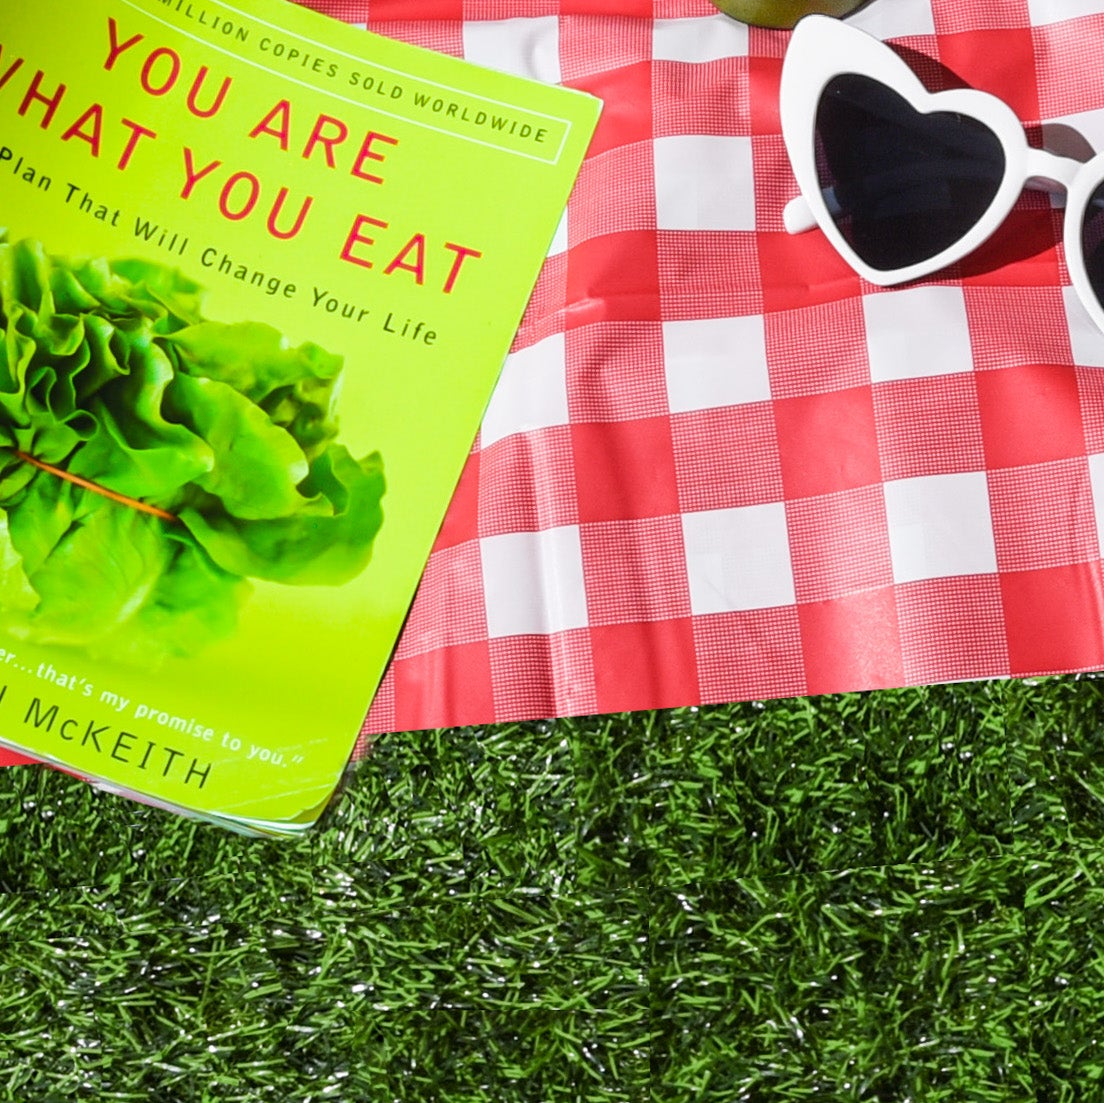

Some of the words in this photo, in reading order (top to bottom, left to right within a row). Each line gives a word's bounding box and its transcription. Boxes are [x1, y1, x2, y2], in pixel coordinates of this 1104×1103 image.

[103, 16, 233, 118] YOU
[248, 98, 399, 185] ARE
[259, 38, 339, 78] COPIES
[349, 71, 403, 100] SOLD
[413, 92, 548, 143] WORLDWIDE
[65, 182, 121, 227] That
[134, 217, 189, 256] Will
[201, 248, 297, 298] Change
[312, 287, 370, 322] Your
[383, 313, 437, 346] Life
[180, 146, 314, 240] YOU
[339, 213, 482, 294] EAT
[23, 697, 212, 789] McKEITH
[100, 690, 130, 712] my
[134, 703, 215, 742] promise
[221, 731, 242, 751] to
